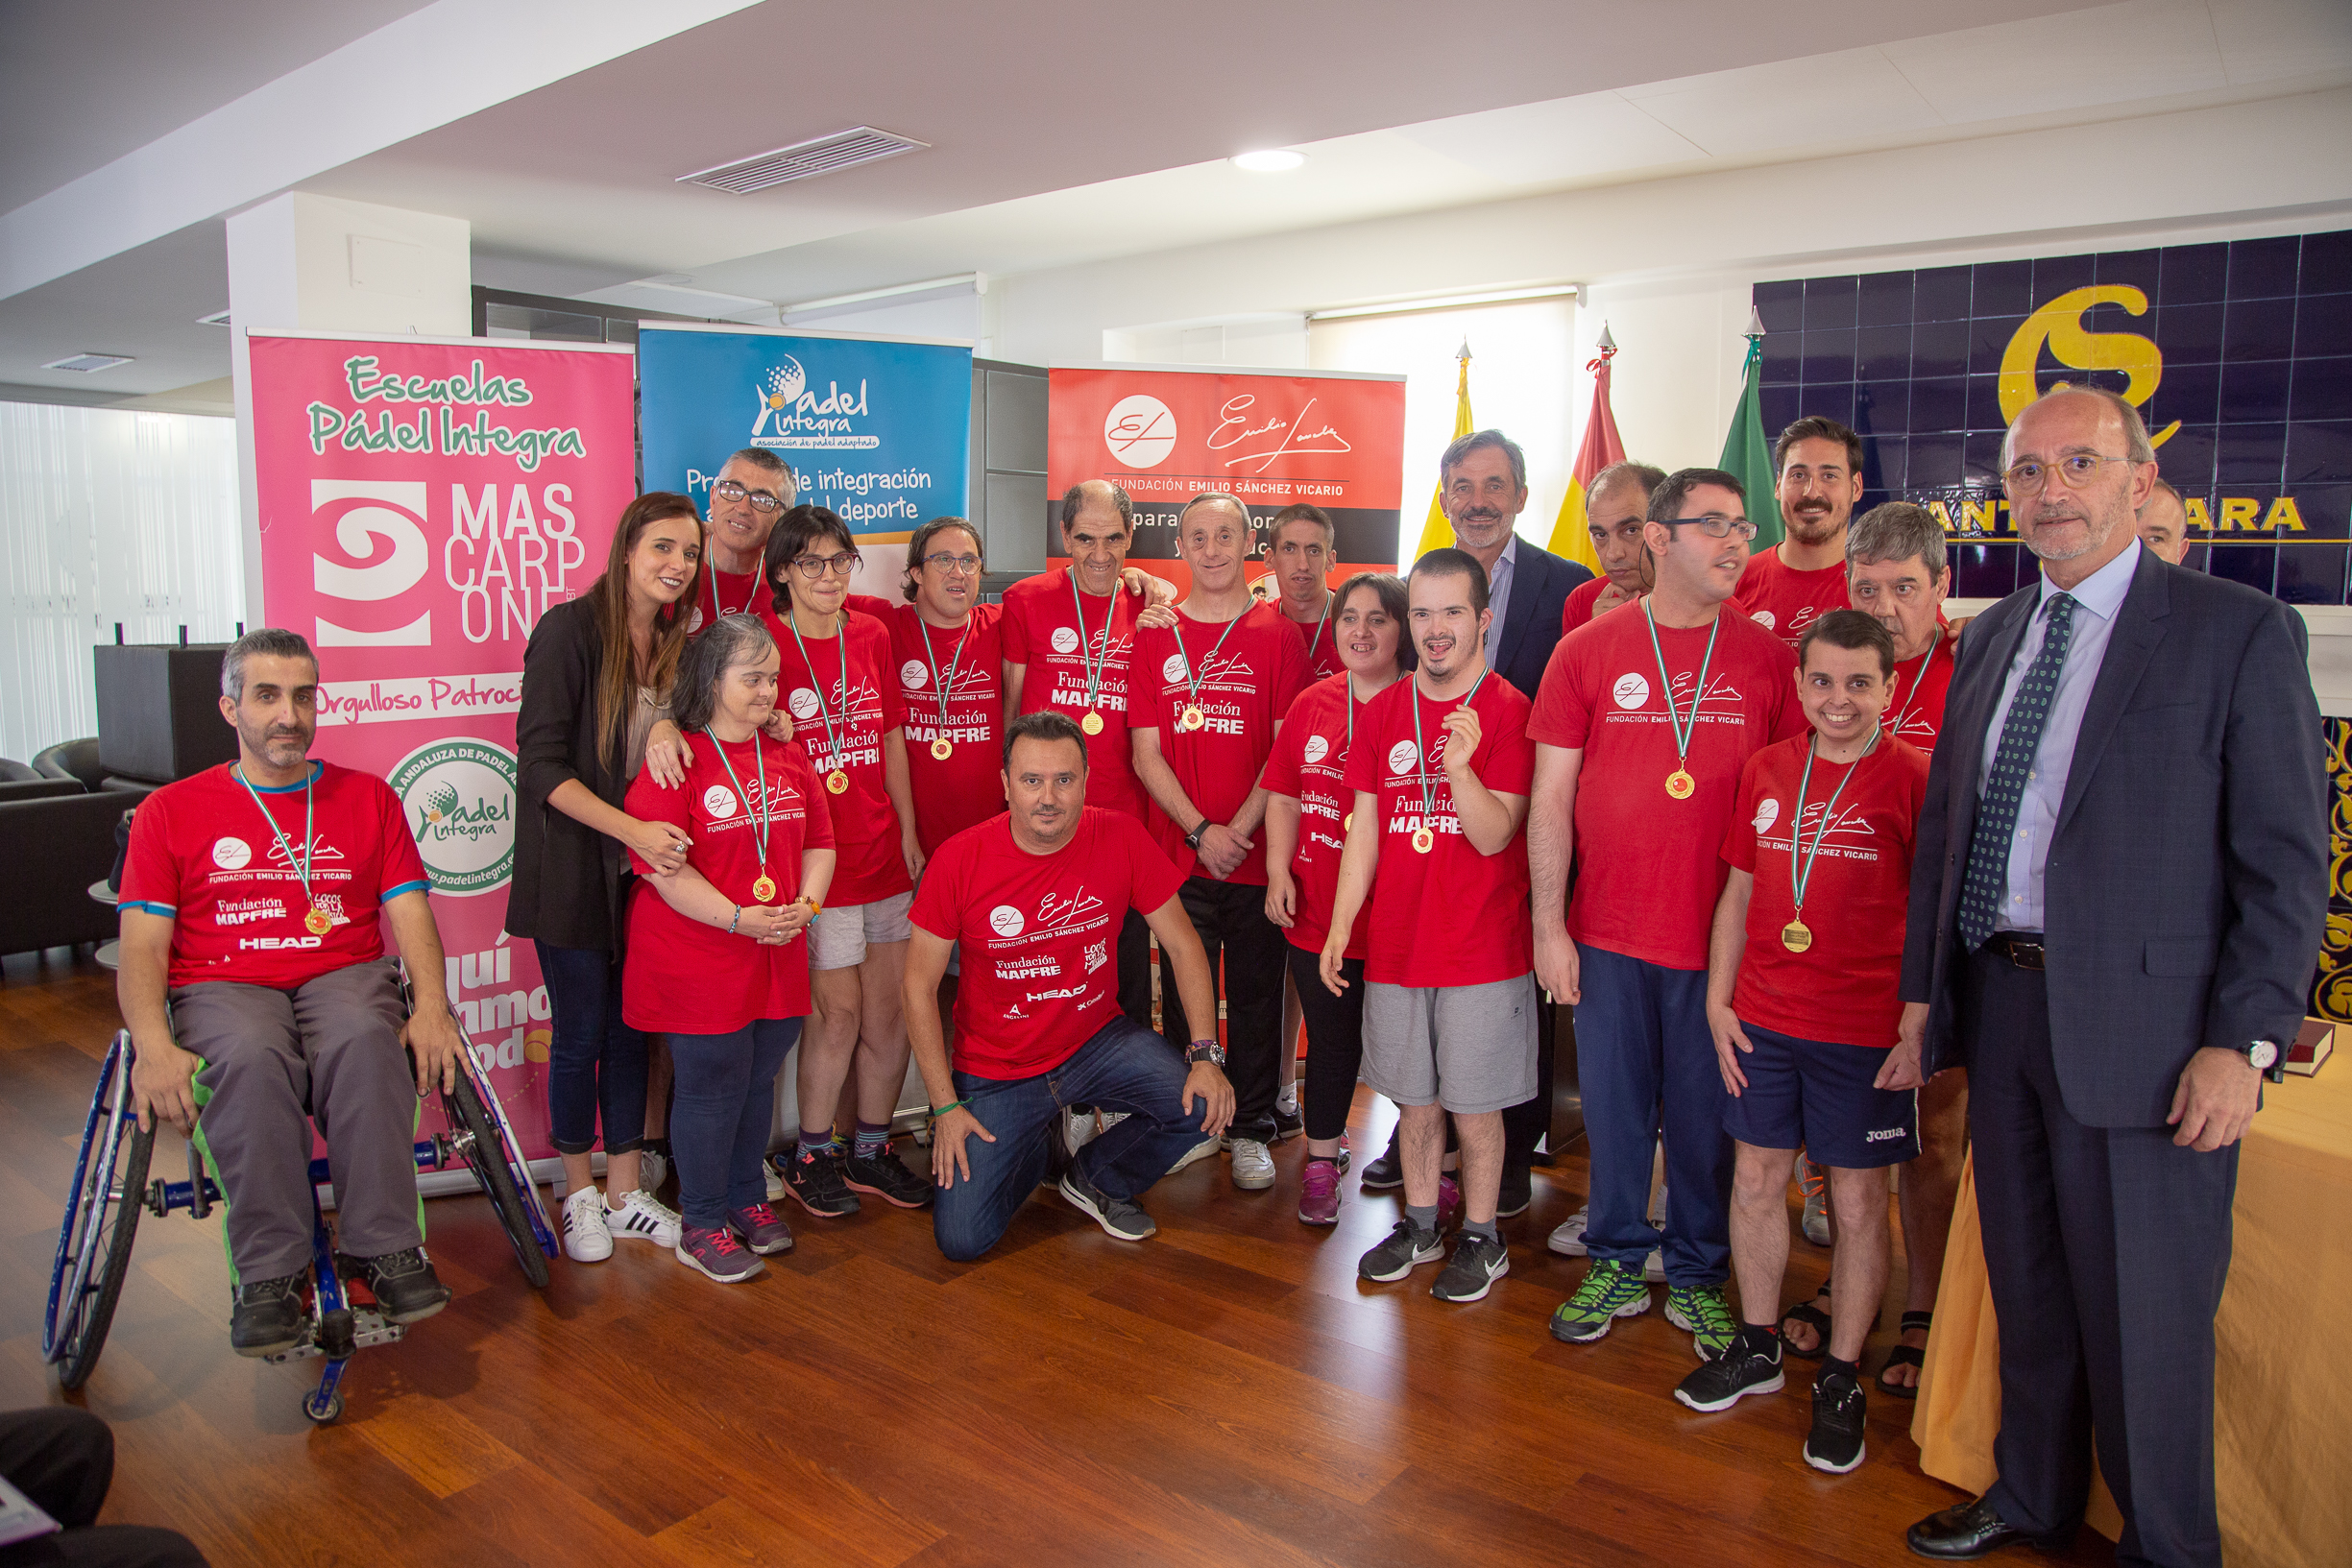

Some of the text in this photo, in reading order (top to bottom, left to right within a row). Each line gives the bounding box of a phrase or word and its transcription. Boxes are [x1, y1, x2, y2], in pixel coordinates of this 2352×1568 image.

[345, 355, 533, 407] Escuelas
[307, 400, 587, 471] Pádel Integra
[757, 438, 877, 449] asociación de padel adaptado
[818, 467, 932, 495] integración
[1189, 481, 1230, 493] EMILIO
[1235, 480, 1292, 495] SÁNCHEZ
[1297, 484, 1344, 496] VICARIO
[451, 483, 576, 540] MAS
[838, 496, 919, 525] deporte
[445, 535, 586, 592] CARP
[1233, 686, 1256, 694] VICARIO
[316, 683, 423, 725] Orgulloso
[1606, 714, 1648, 723] FUNDACIÓN
[400, 748, 510, 787] ANDALUZA DE PADEL
[707, 819, 745, 833] FUNDACIÓN
[1844, 850, 1878, 860] VICARIO
[209, 873, 254, 884] FUNDACIÓN
[323, 873, 352, 881] VICARIO
[215, 906, 287, 926] MAPFRE
[988, 916, 1109, 950] FUNDACIÓN EMILIO SÁNCHEZ VICARIO
[239, 936, 322, 950] HEAD
[995, 954, 1055, 969] Fundación
[995, 965, 1061, 980] MAPFRE
[1027, 983, 1087, 1001] HEAD
